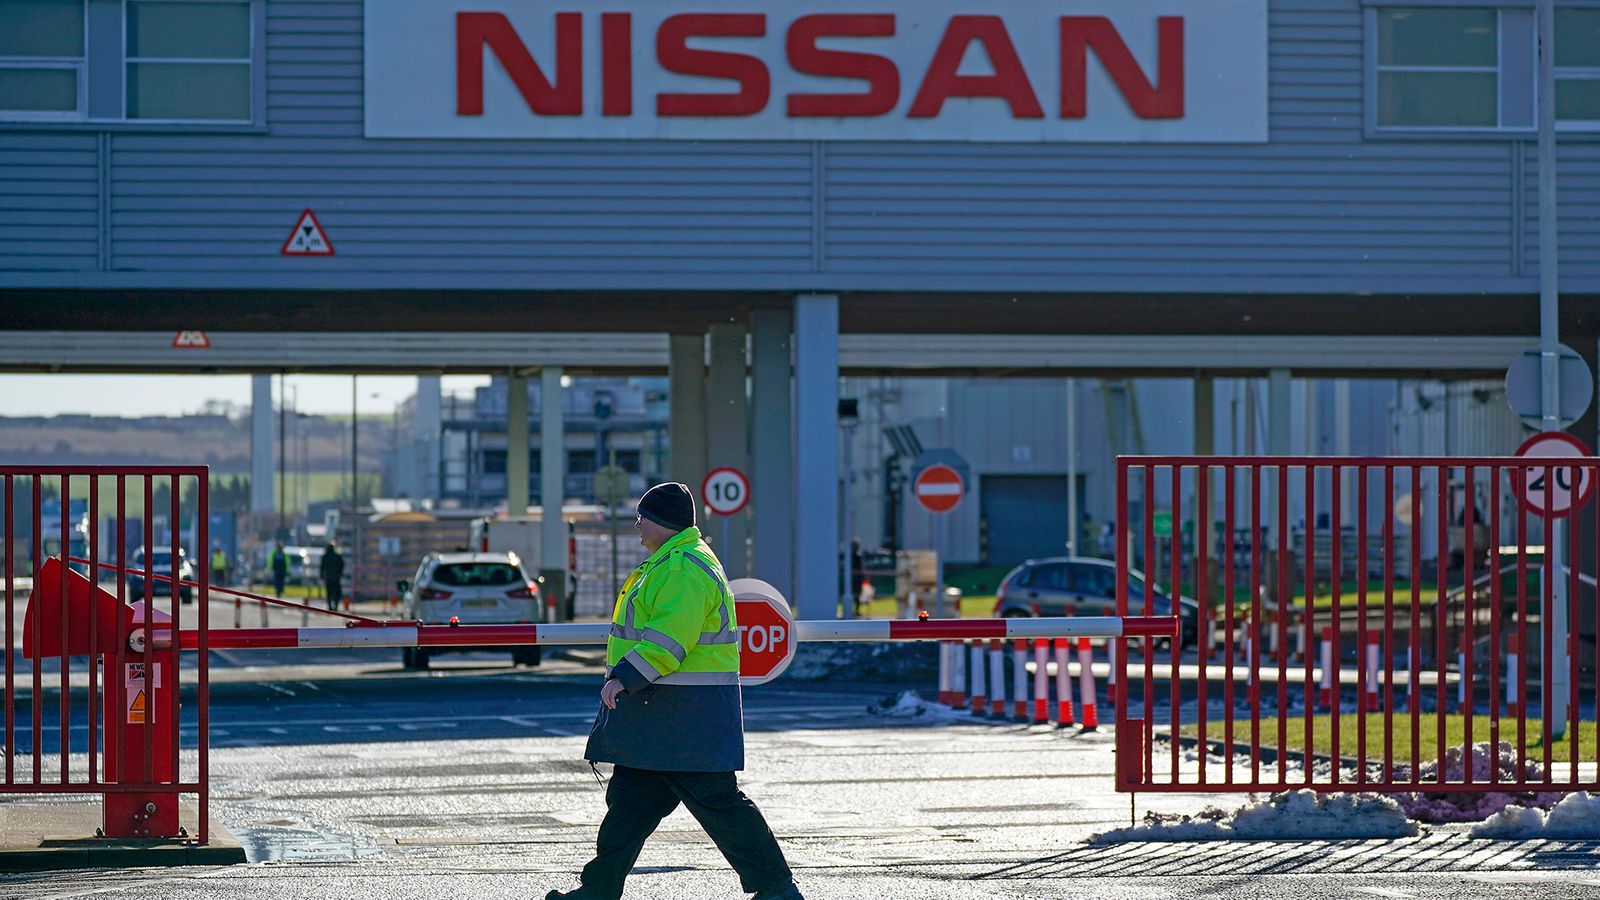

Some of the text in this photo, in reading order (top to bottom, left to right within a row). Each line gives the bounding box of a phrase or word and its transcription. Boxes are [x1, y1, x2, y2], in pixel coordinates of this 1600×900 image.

[456, 12, 1184, 119] NISSAN
[712, 482, 740, 502] 10
[737, 625, 785, 653] TOP
